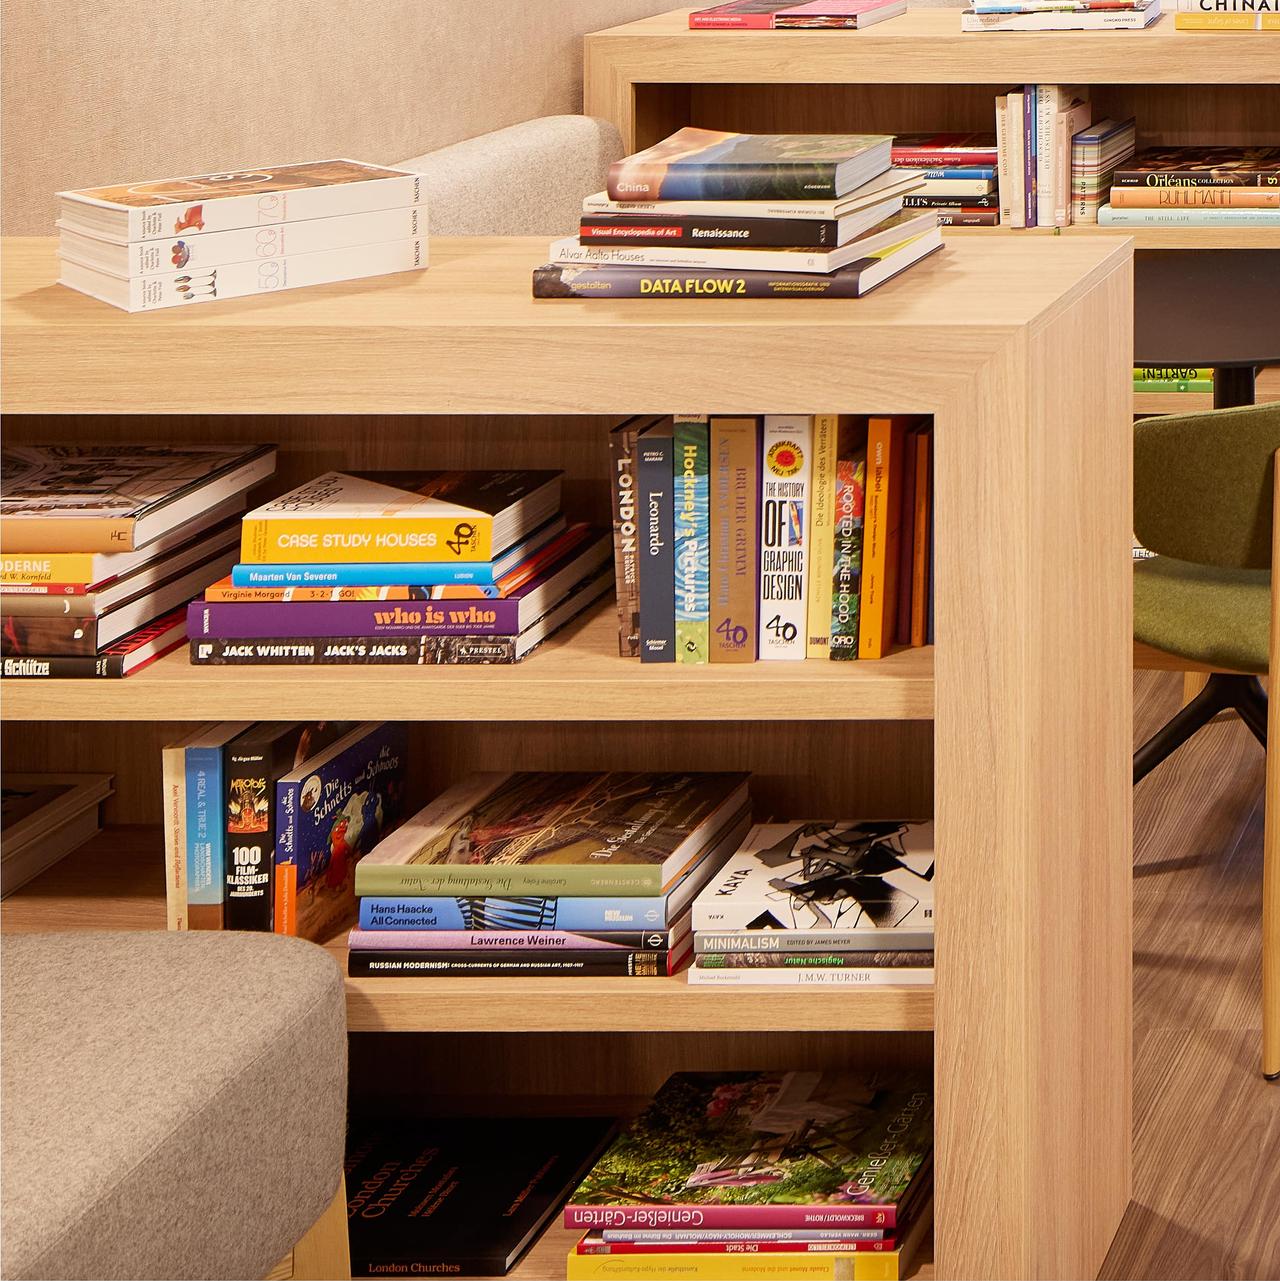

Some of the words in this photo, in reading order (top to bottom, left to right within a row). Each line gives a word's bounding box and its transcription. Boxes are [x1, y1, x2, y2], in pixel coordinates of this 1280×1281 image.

[616, 183, 649, 192] China
[1160, 190, 1232, 205] RUHLMANN
[592, 228, 612, 236] Visual
[612, 228, 656, 238] Encyclopedia
[656, 228, 664, 236] of
[664, 228, 676, 236] Art
[692, 228, 750, 238] Renaissance
[559, 249, 582, 260] Alvar
[584, 249, 610, 261] Aalto
[611, 251, 644, 262] Houses
[571, 281, 611, 291] gestalten
[640, 279, 683, 293] DATA
[686, 279, 734, 293] FLOW
[736, 279, 746, 293] 2
[1143, 368, 1198, 379] GARTEN!
[818, 418, 827, 454] Verräters
[772, 464, 784, 476] NEJ
[786, 466, 800, 476] TAK
[817, 457, 826, 471] des
[875, 466, 883, 492] label
[680, 445, 698, 537] Hockney's
[766, 482, 778, 496] THE
[778, 482, 804, 497] HISTORY
[816, 474, 827, 510] Ideologie
[617, 458, 636, 552] LONDON
[842, 484, 854, 536] ROOTED
[649, 492, 664, 556] Leonardo
[764, 500, 787, 548] OF
[278, 534, 318, 548] CASE
[322, 533, 371, 548] STUDY
[376, 532, 436, 546] HOUSES
[446, 522, 474, 556] 40
[842, 538, 850, 554] IN
[736, 528, 747, 576] GRIMM
[763, 550, 803, 572] GRAPHIC
[250, 572, 284, 581] Maarten
[286, 572, 302, 580] Van
[303, 572, 338, 580] Severen
[683, 539, 698, 612] Pictures
[840, 556, 851, 586] THE
[221, 590, 253, 600] Virginie
[254, 590, 290, 600] Morgand
[762, 574, 802, 601] DESIGN
[838, 588, 850, 624] HOOD
[374, 606, 419, 624] who
[426, 606, 444, 624] is
[449, 606, 496, 624] who
[716, 618, 748, 646] 40
[766, 614, 798, 641] 40
[222, 646, 253, 656] JACK
[255, 646, 314, 656] WHITTEN
[324, 646, 366, 656] JACK'S
[368, 646, 408, 656] JACKS
[4, 658, 50, 676] Schütze
[379, 744, 390, 758] die
[366, 756, 399, 780] Schmoos
[354, 770, 366, 785] und
[198, 778, 206, 800] REAL
[324, 777, 340, 798] Die
[285, 788, 294, 814] Schmoos
[314, 782, 352, 826] Schnetts
[198, 810, 207, 832] TRUE
[285, 826, 293, 852] Schnetts
[232, 846, 261, 865] 100
[236, 866, 258, 876] FILM-
[226, 874, 268, 885] KLASSIKER
[400, 879, 428, 891] Natur
[432, 878, 446, 890] der
[447, 875, 494, 891] Gestaltung
[496, 878, 512, 891] Die
[716, 868, 752, 897] KAYA
[370, 904, 395, 915] Hans
[396, 904, 433, 915] Haacke
[370, 916, 384, 925] All
[384, 916, 437, 926] Connected
[470, 935, 526, 946] Lawrence
[526, 935, 566, 946] Weiner
[703, 936, 780, 950] MINIMALISM
[808, 956, 844, 965] Magische
[798, 974, 828, 983] J.M.W.
[829, 974, 871, 982] TURNER
[574, 1210, 704, 1225] Genießer-Gärten
[368, 1263, 408, 1273] London
[410, 1262, 460, 1273] Churches
